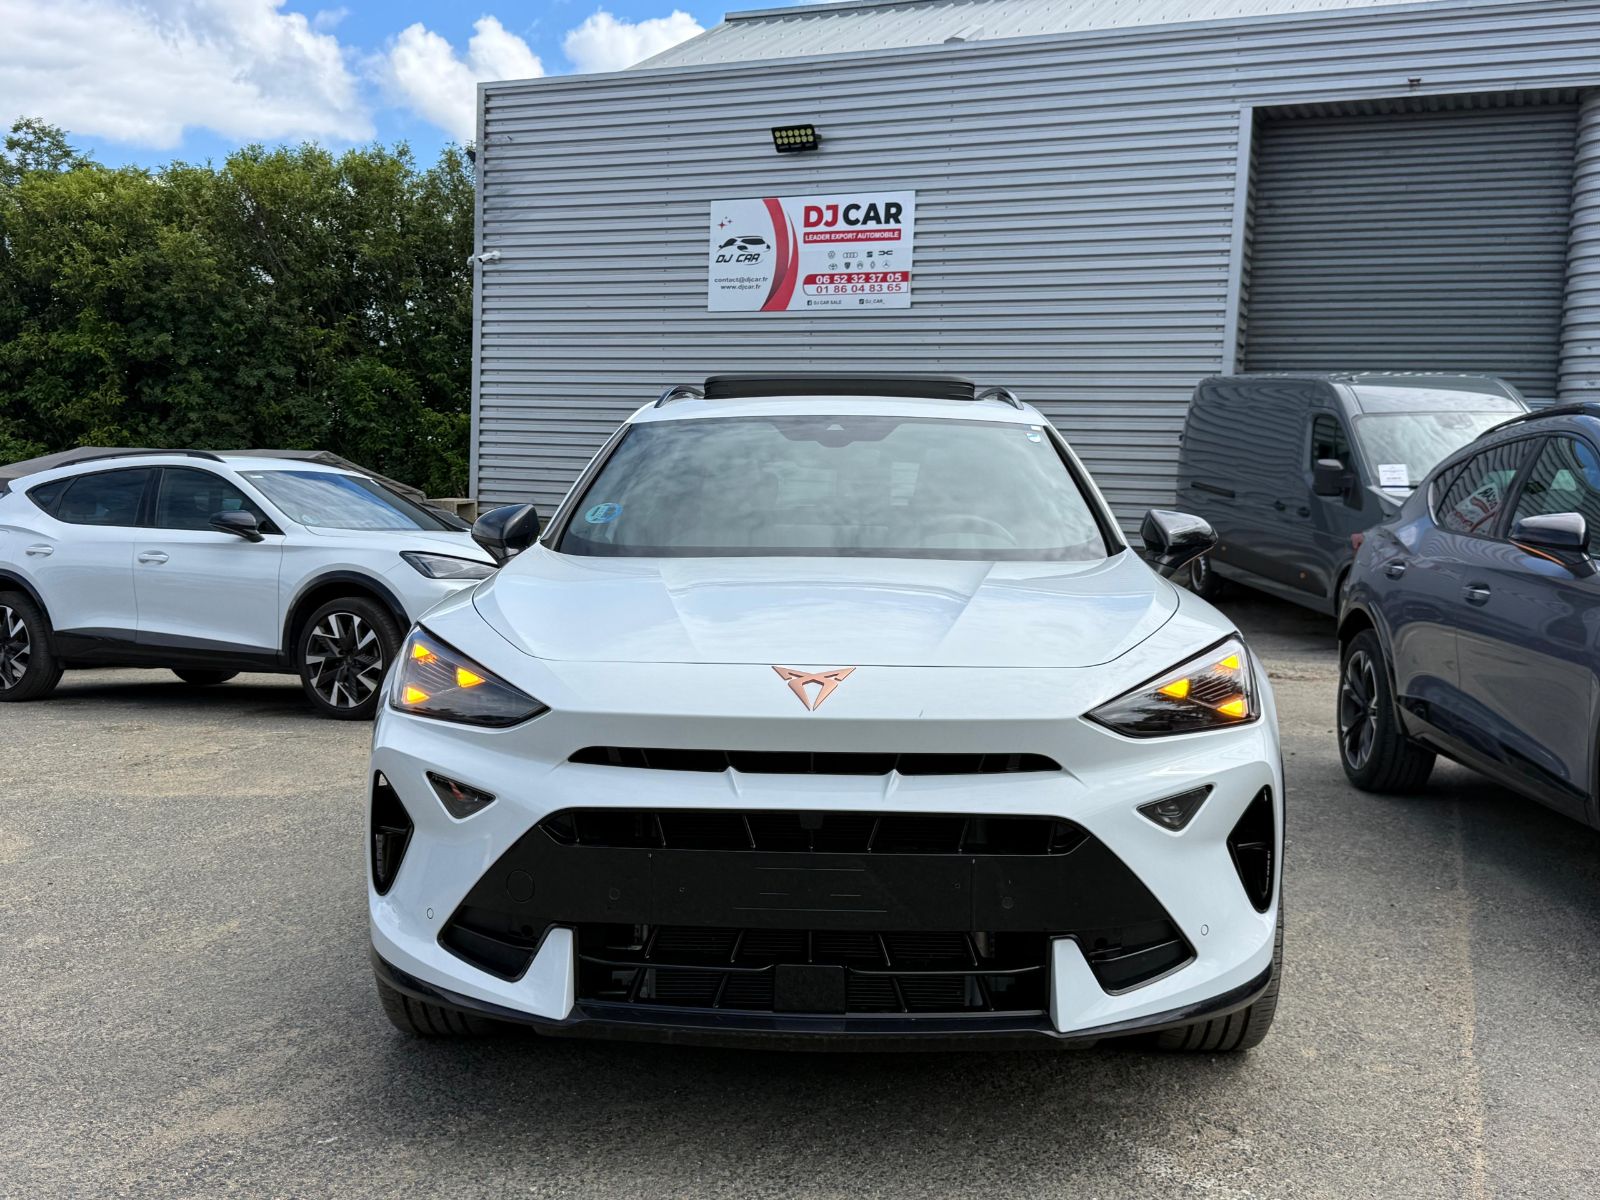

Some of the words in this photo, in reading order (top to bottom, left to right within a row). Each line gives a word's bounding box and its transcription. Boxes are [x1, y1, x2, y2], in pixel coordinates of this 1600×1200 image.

[805, 233, 830, 241] LEADER
[832, 232, 856, 240] EXPORT
[857, 231, 899, 239] AUTOMOBILE
[716, 254, 733, 263] DJ
[816, 275, 830, 284] 06
[834, 275, 847, 284] 52
[851, 274, 865, 283] 32
[869, 274, 883, 282] 37
[887, 273, 902, 281] 05
[816, 286, 829, 294] 01
[834, 285, 847, 294] 86
[851, 285, 865, 293] 04
[869, 284, 883, 292] 83
[887, 284, 902, 292] 65
